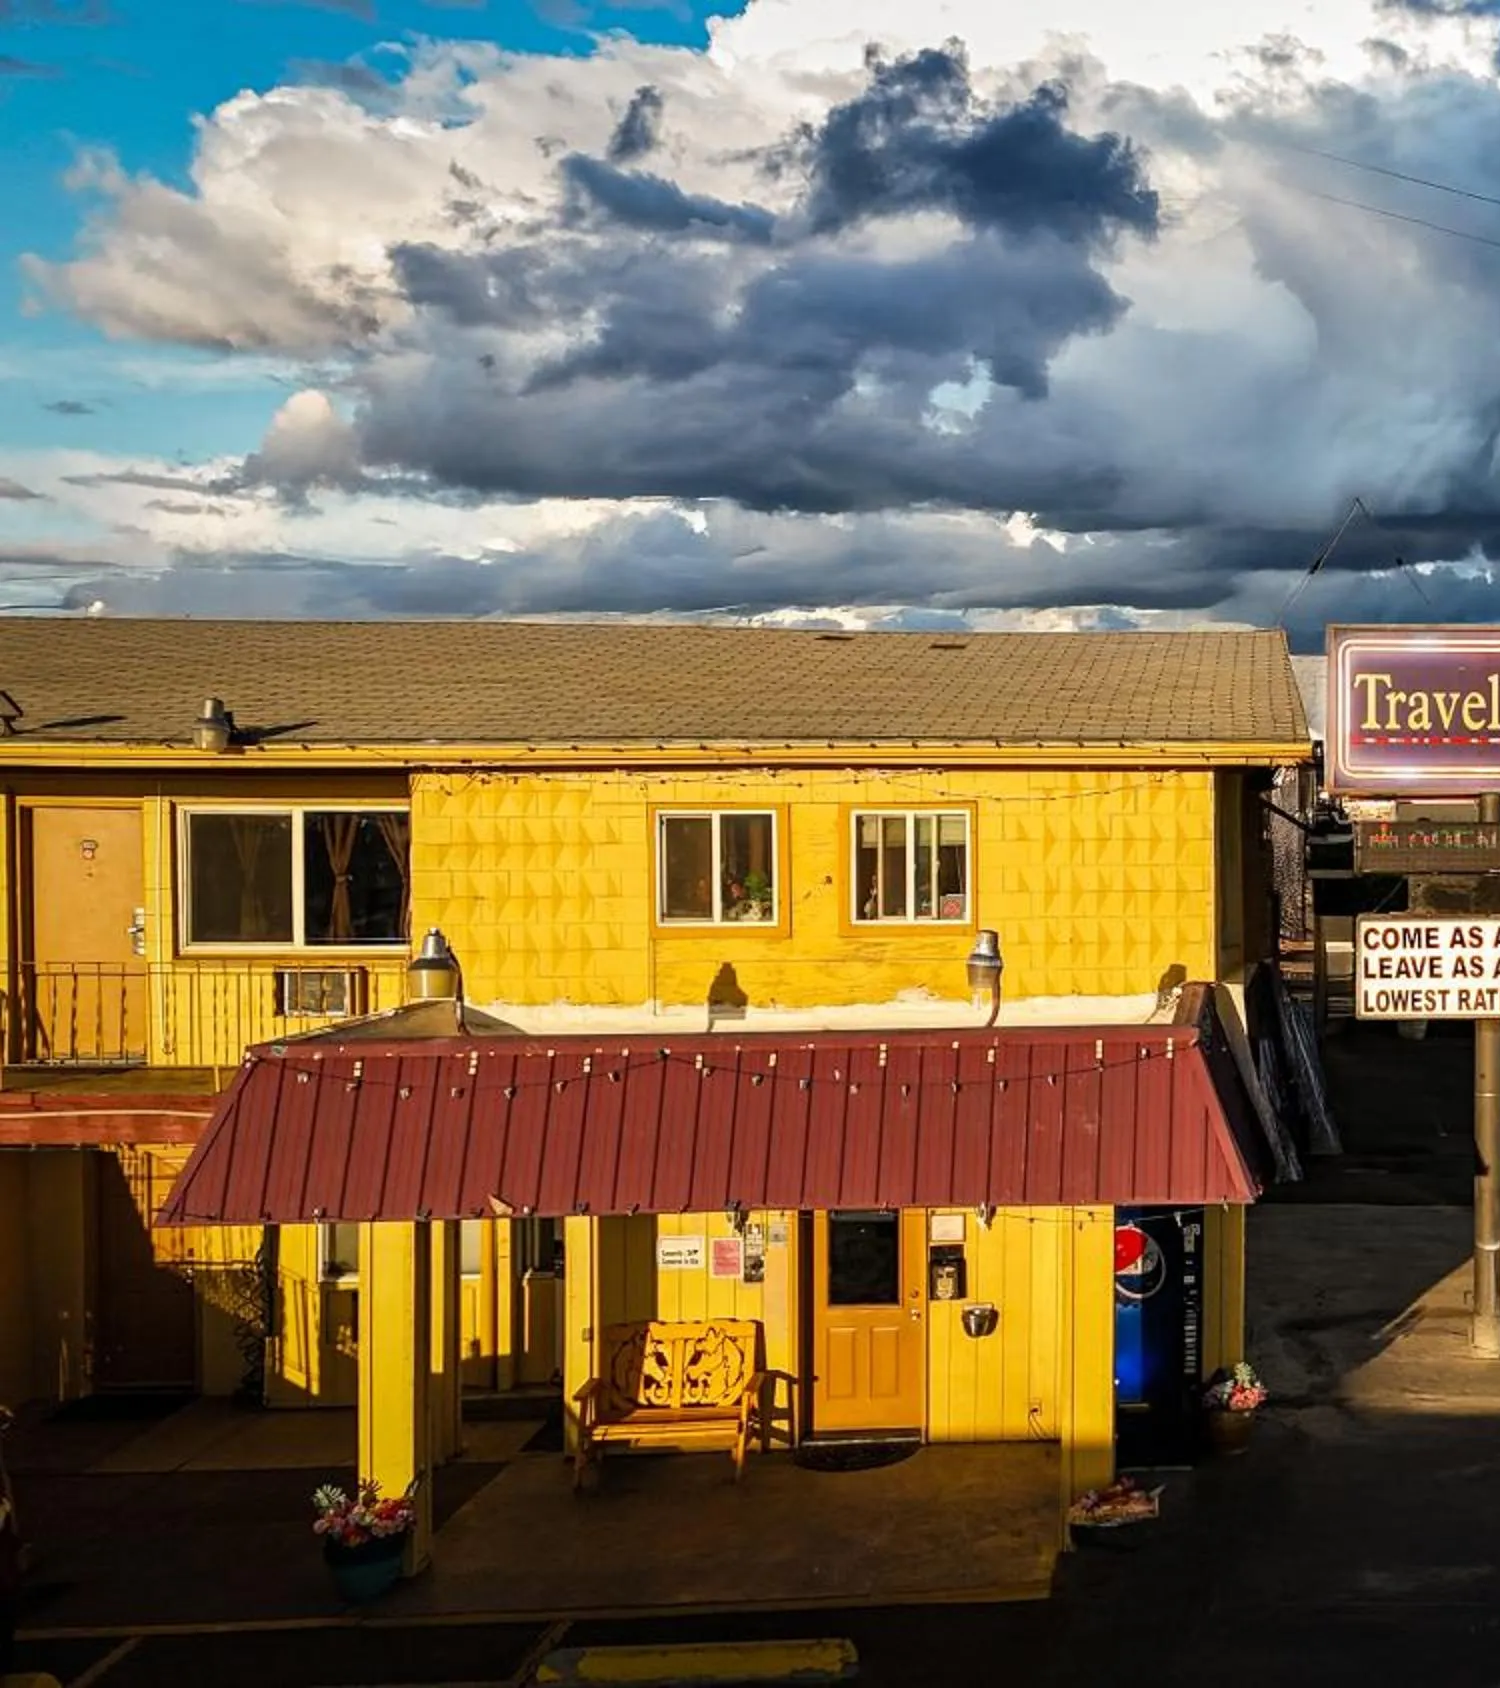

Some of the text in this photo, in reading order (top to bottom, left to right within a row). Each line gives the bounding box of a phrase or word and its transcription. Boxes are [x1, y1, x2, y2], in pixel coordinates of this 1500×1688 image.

[1363, 927, 1440, 950] COME
[1449, 926, 1484, 949] AS
[1363, 956, 1443, 979] LEAVE
[1451, 956, 1485, 978] AS
[1363, 989, 1451, 1012] LOWEST
